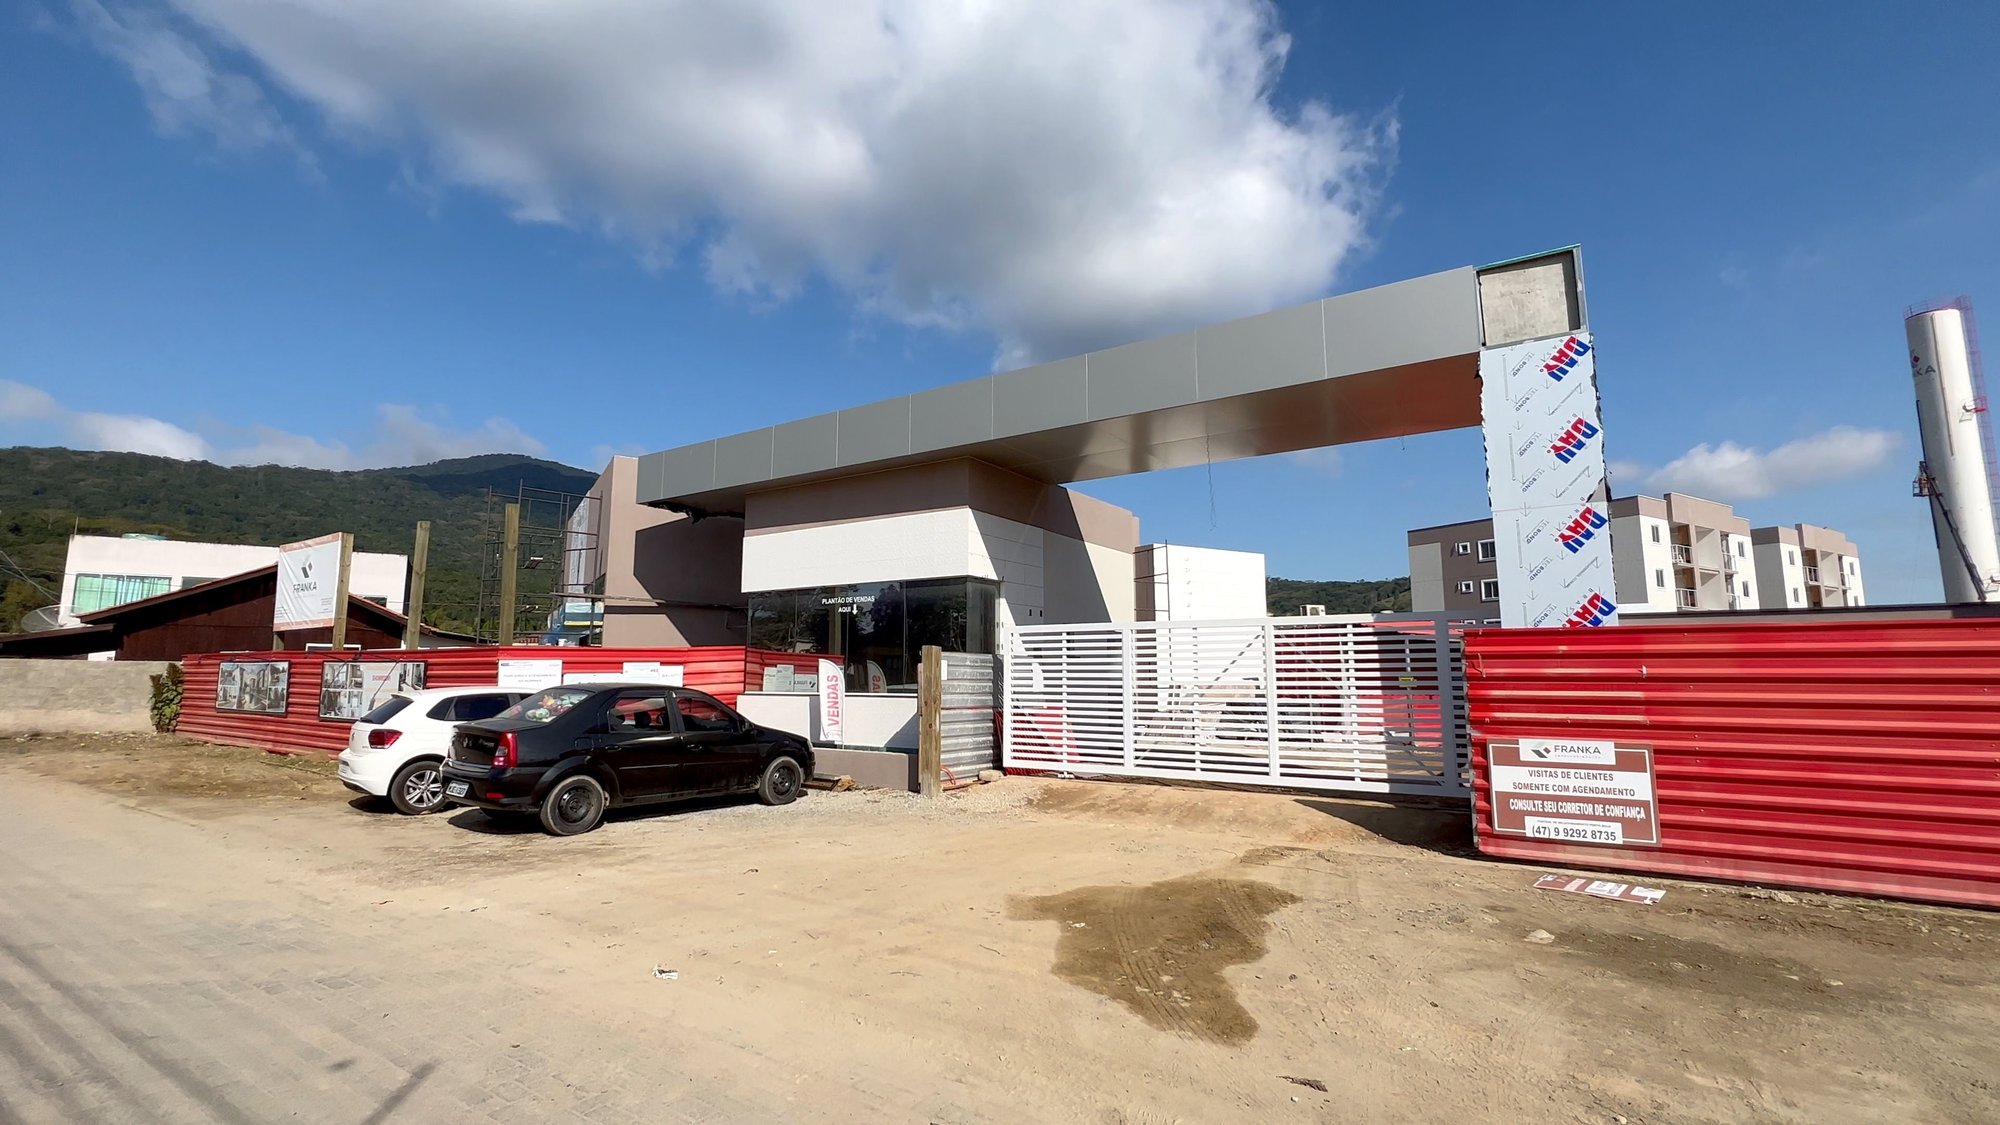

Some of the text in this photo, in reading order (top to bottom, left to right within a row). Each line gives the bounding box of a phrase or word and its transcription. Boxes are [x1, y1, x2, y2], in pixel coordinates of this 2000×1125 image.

[1543, 335, 1591, 382] DAY
[1550, 416, 1599, 464] DAY
[1558, 506, 1608, 554] DAY
[821, 595, 876, 605] PLANTÃO DE VENDAS
[826, 674, 840, 727] VENDAS
[1553, 744, 1602, 755] FRANKA
[1528, 769, 1614, 782] VISITAS DE CLIENTES
[1512, 782, 1636, 797] SOMENTE COM AGENDAMENTO
[1509, 798, 1646, 821] CONSULTE SEU CORRETOR DE CONFIANÇA
[1532, 825, 1617, 841] (47) 9 9292 8735
